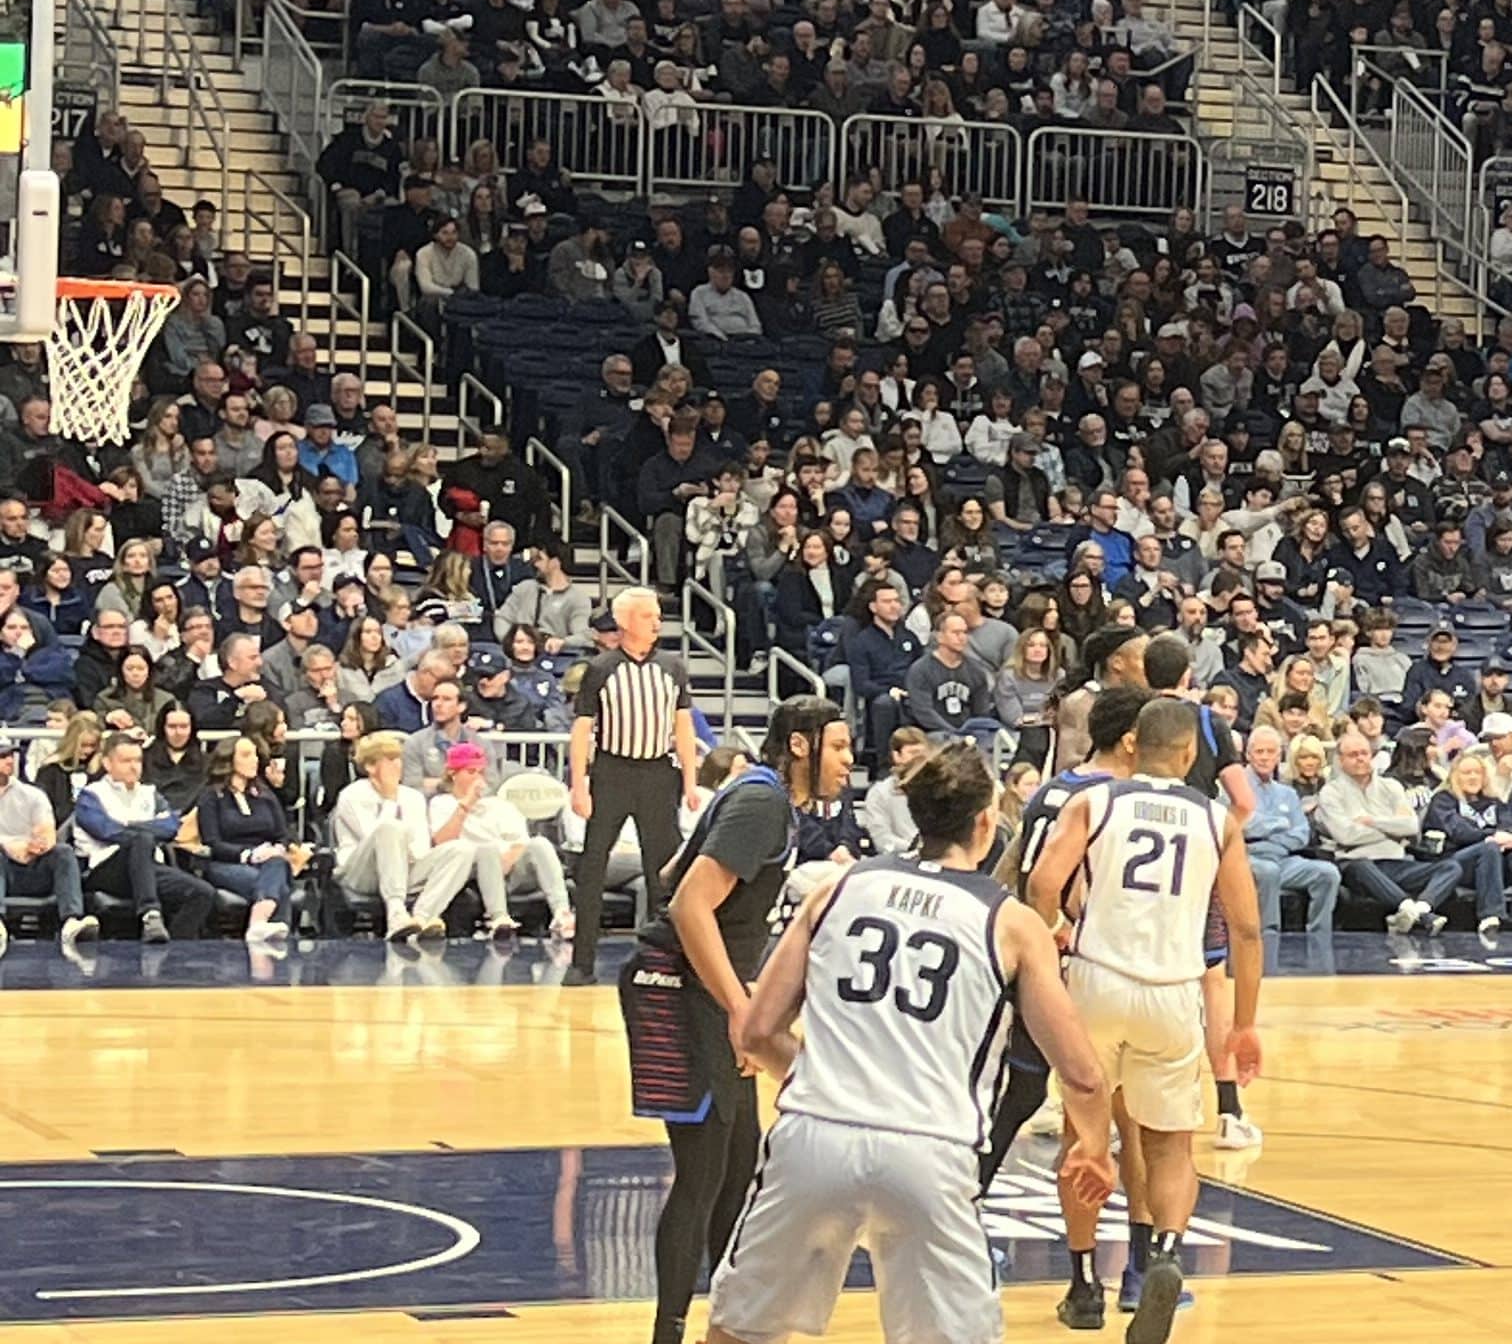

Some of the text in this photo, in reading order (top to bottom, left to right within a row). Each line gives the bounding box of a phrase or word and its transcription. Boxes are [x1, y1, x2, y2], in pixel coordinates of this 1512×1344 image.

[1251, 183, 1288, 212] 218
[1021, 815, 1057, 874] 1
[1122, 828, 1188, 896] 21
[886, 885, 944, 919] KAPKE
[837, 916, 960, 1023] 33
